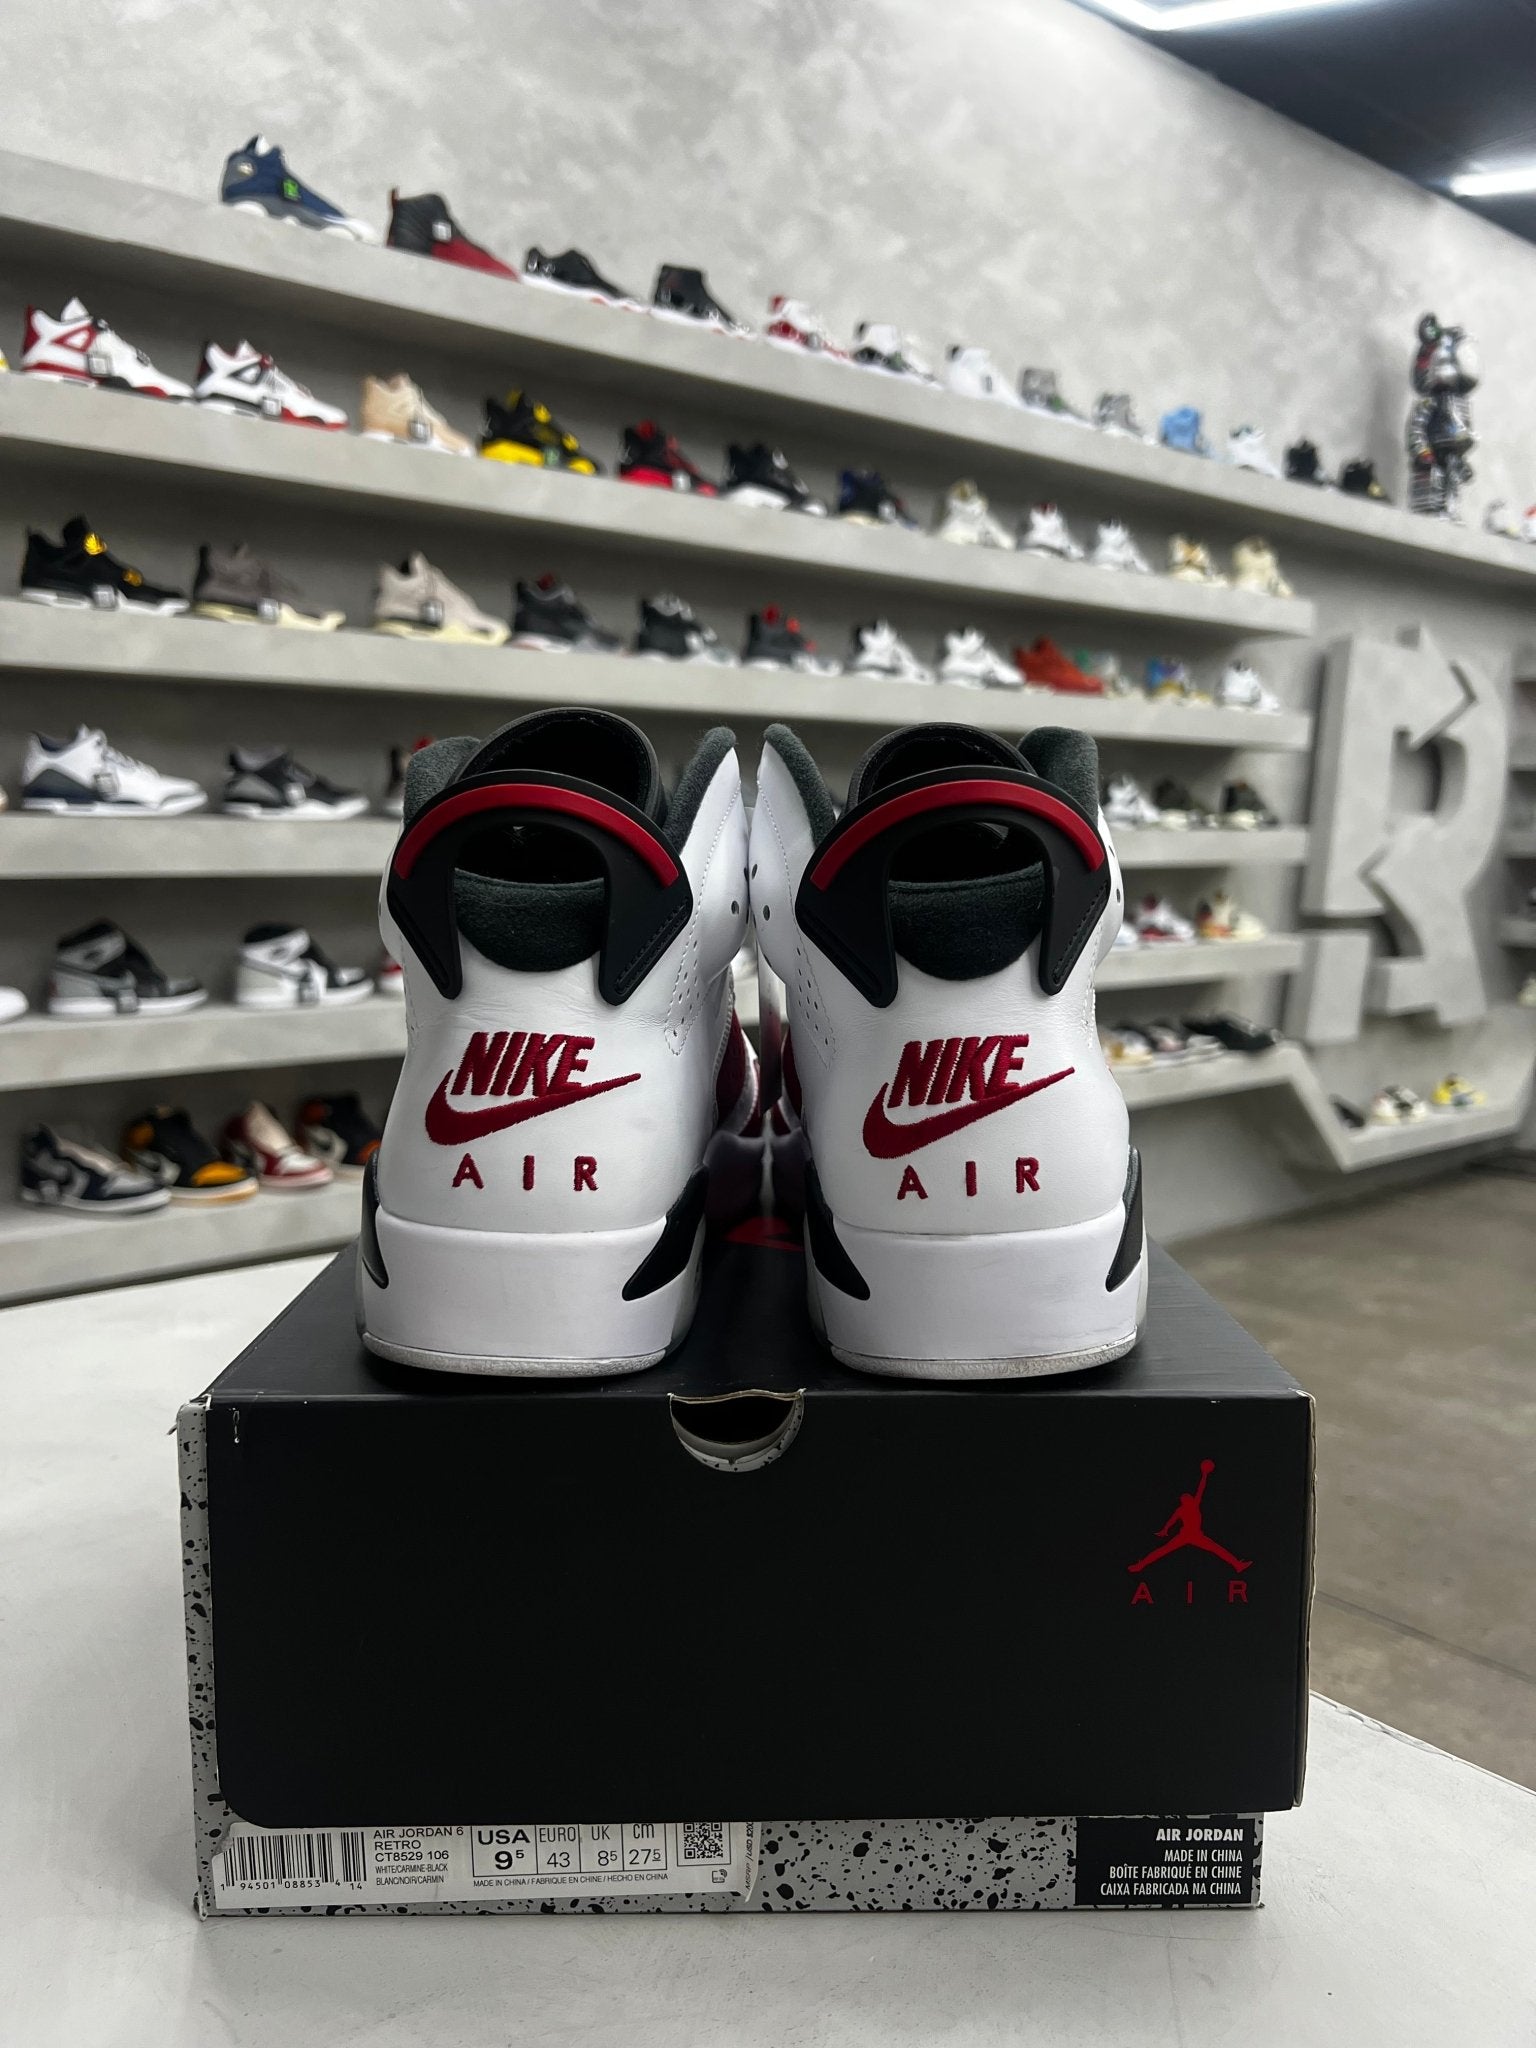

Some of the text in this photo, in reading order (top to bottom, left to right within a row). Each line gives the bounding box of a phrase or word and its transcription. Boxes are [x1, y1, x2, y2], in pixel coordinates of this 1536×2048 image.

[450, 1031, 596, 1097] NIKE
[887, 1034, 1029, 1108] NIKE
[451, 1152, 599, 1191] AIR
[896, 1156, 1040, 1200] AIR
[1131, 1580, 1248, 1605] AIR
[373, 1826, 464, 1839] AIR JORDAN 6
[477, 1829, 531, 1845] USA
[539, 1827, 577, 1843] EURO
[591, 1825, 611, 1840] UK
[1155, 1828, 1244, 1841] AIR JORDAN
[374, 1840, 422, 1850] RETRO
[375, 1850, 450, 1862] CT8529 106
[546, 1852, 571, 1868] 43
[1164, 1849, 1243, 1862] MADE IN CHINA
[1109, 1863, 1242, 1879] BOÎTE FABRIQUÉ EN CHINE
[220, 1879, 363, 1892] 1 94501 08853 4 14
[473, 1879, 494, 1887] MADE
[495, 1879, 503, 1887] IN
[504, 1877, 527, 1886] CHINA
[531, 1876, 566, 1885] FABRIQUE
[568, 1876, 579, 1884] EN
[580, 1875, 602, 1884] CHINE
[608, 1874, 633, 1883] HECHO
[634, 1873, 645, 1882] EN
[645, 1872, 669, 1881] CHINA
[1100, 1882, 1242, 1896] CAIXA FABRICADA NA CHINA
